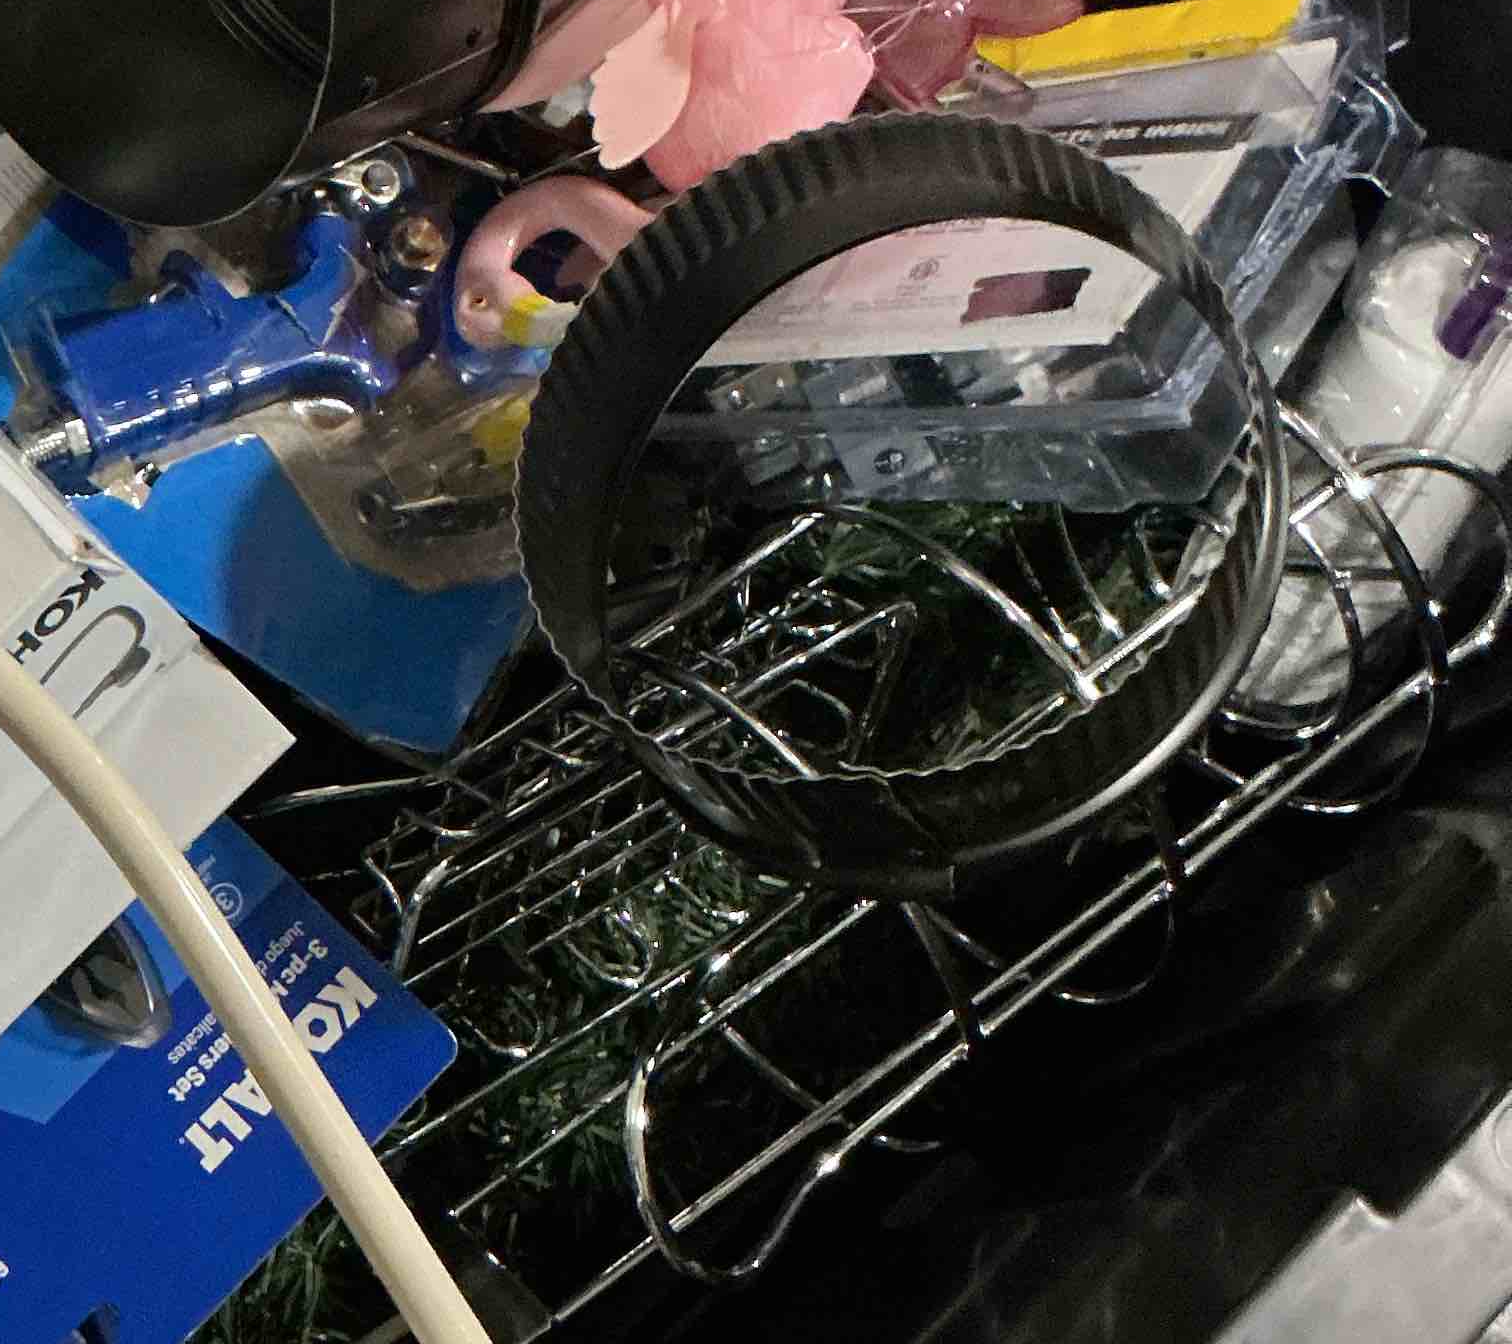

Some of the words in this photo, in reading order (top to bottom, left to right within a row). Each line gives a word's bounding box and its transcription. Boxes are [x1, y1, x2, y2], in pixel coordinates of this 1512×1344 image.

[212, 891, 234, 911] 3
[262, 919, 305, 963] Juego
[280, 939, 328, 984] 3-pc
[167, 1013, 217, 1064] alicates
[166, 1065, 206, 1102] Set
[188, 965, 380, 1174] KOALT
